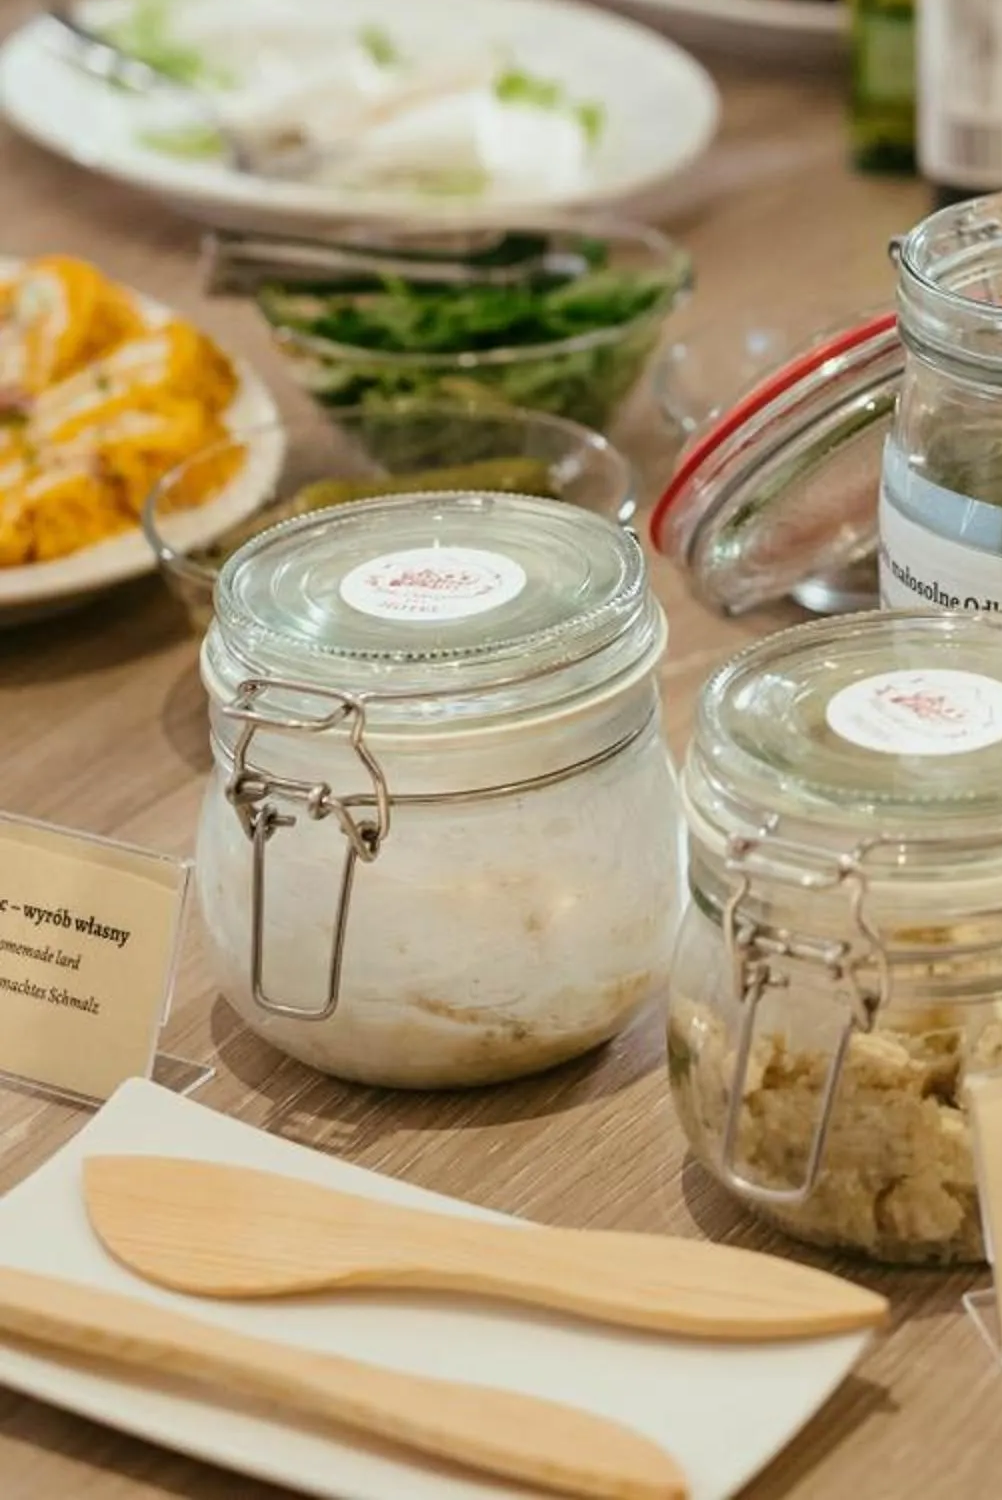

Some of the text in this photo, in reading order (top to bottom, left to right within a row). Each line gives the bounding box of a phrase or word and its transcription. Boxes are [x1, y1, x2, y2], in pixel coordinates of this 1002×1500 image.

[23, 904, 72, 929] wyrób
[75, 915, 131, 949] własny
[55, 949, 82, 970] lard
[48, 986, 100, 1015] Schmalz
